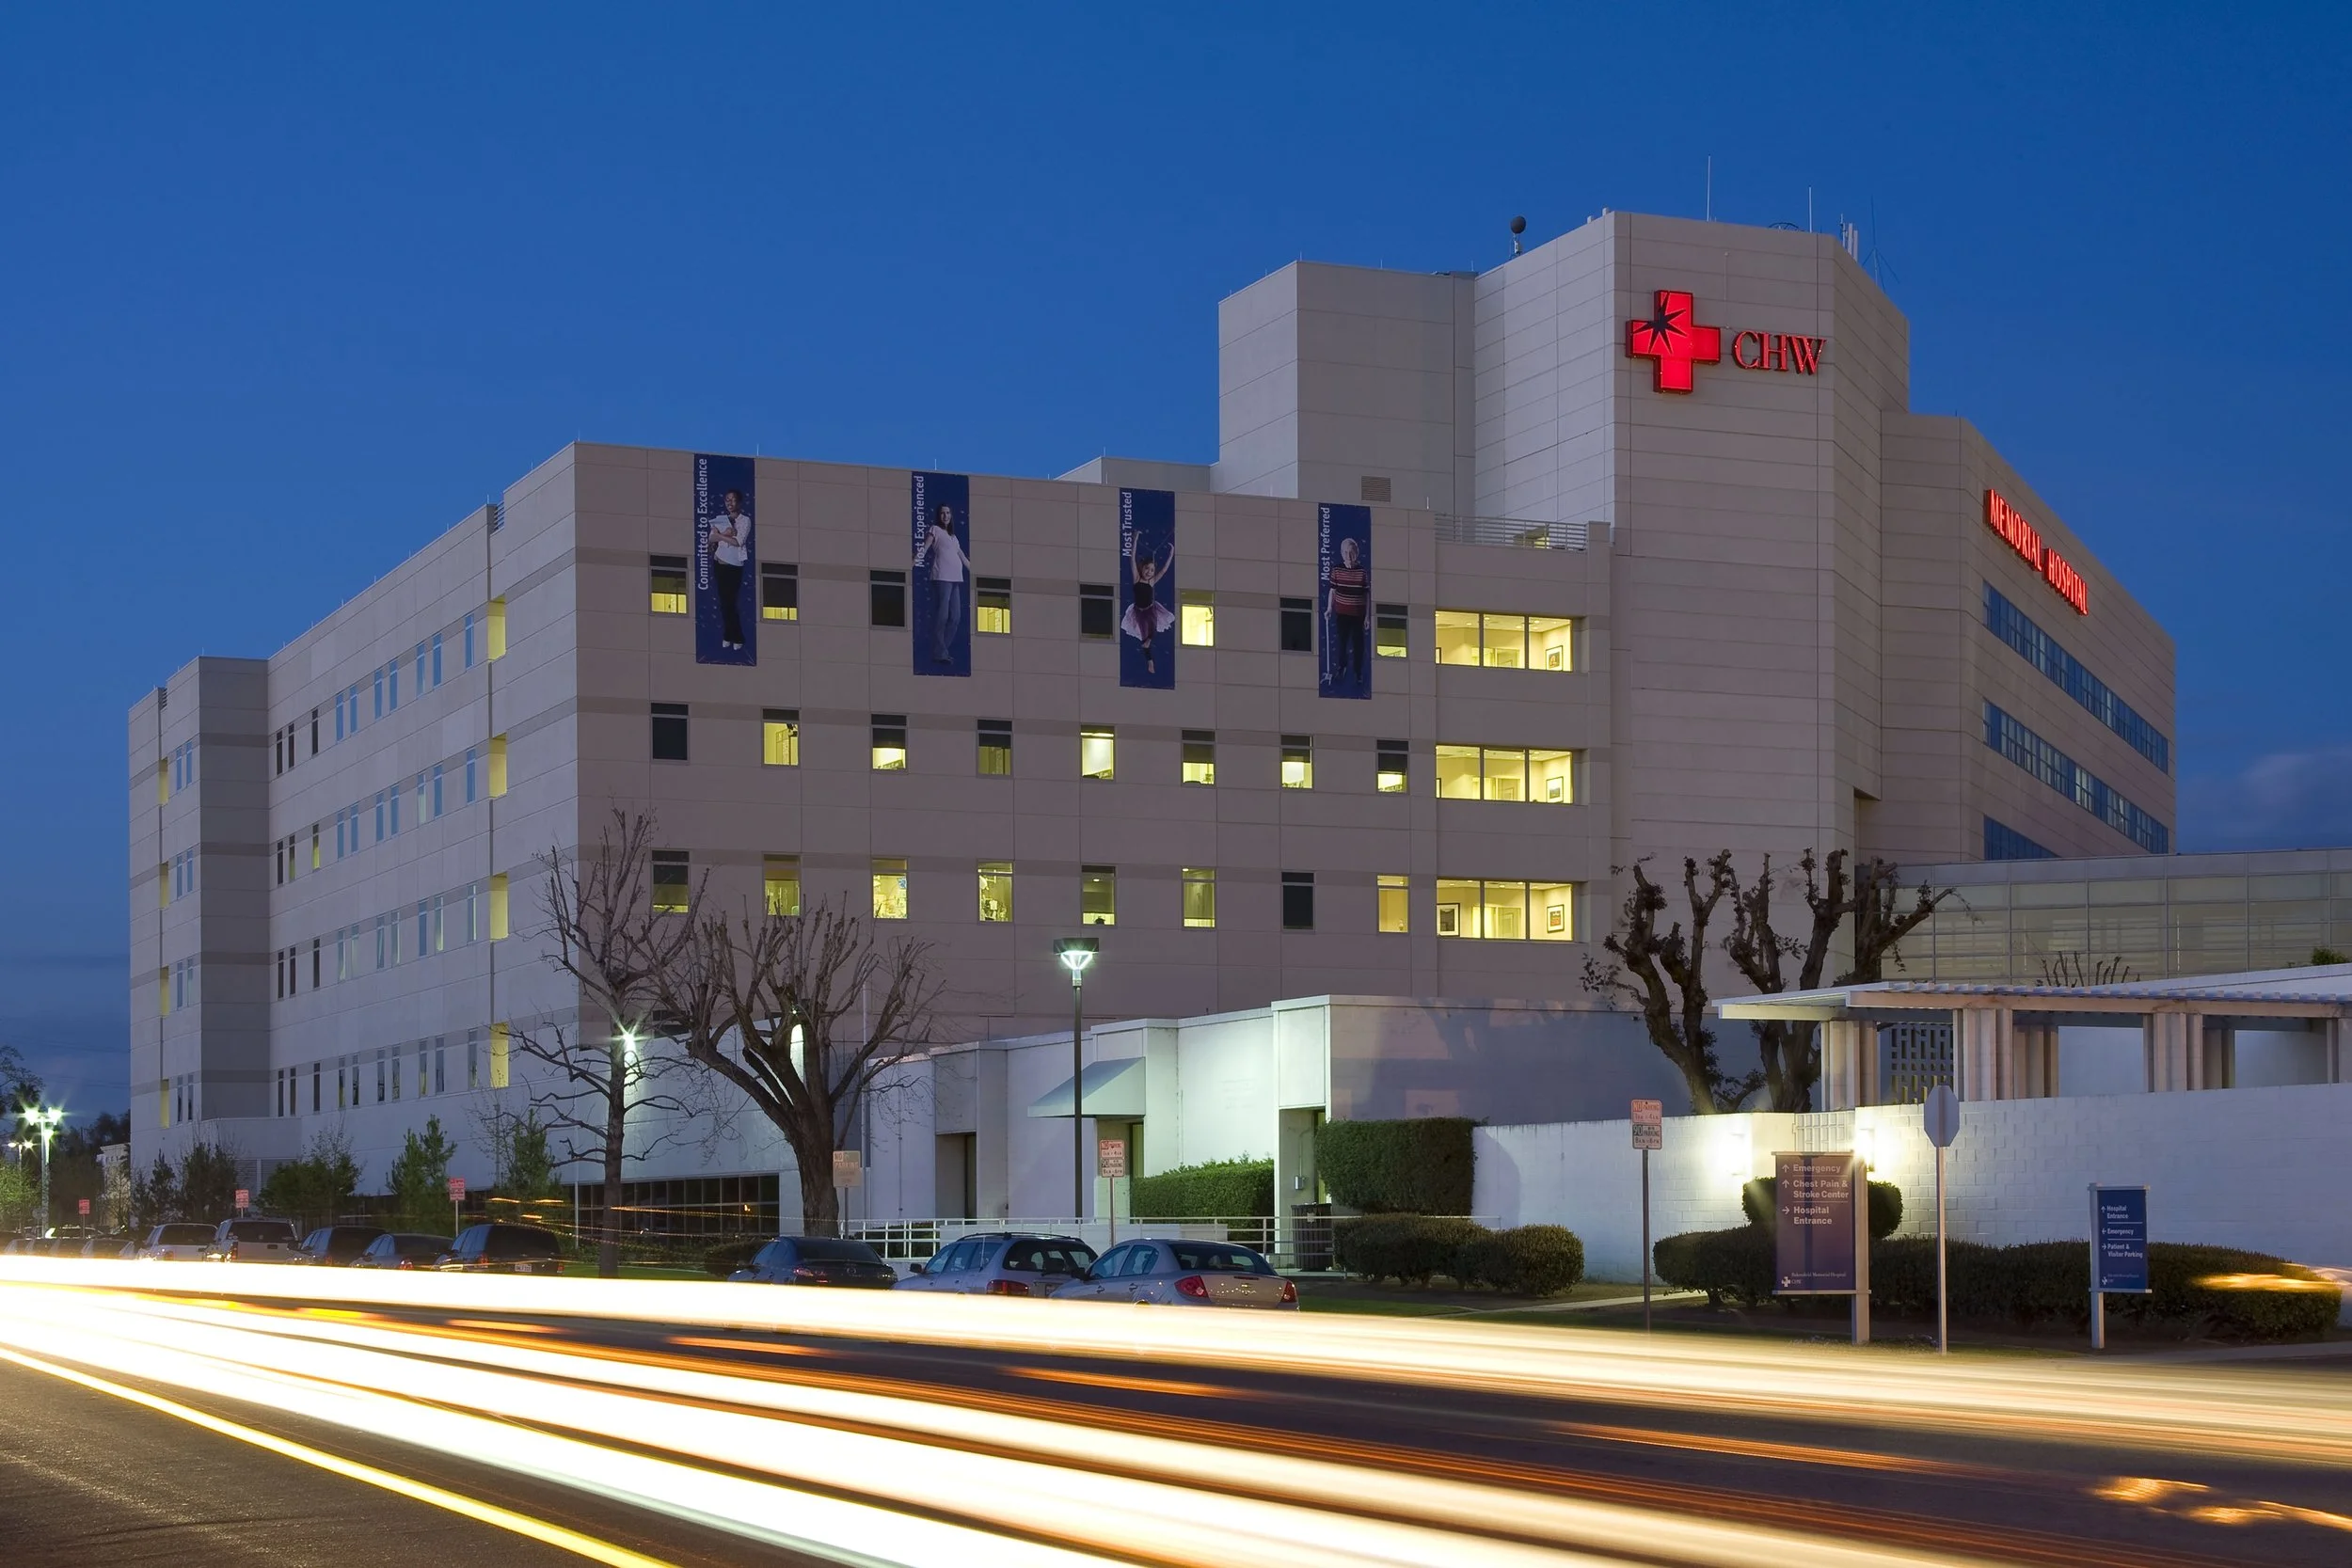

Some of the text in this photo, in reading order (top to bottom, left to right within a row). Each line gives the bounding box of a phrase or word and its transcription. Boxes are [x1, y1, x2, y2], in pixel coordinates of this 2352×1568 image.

[1732, 330, 1827, 375] CHW
[696, 458, 708, 591] Committed to Excellence
[914, 475, 927, 568] Most Experienced
[1121, 491, 1132, 557] Most Trusted
[1320, 507, 1330, 581] Most Preferred
[1986, 489, 2089, 615] MEMORIAL HOSPITAL
[1793, 1164, 1841, 1173] Emergency
[1793, 1180, 1849, 1188] Chest Pain &
[1793, 1206, 1830, 1215] Hospital
